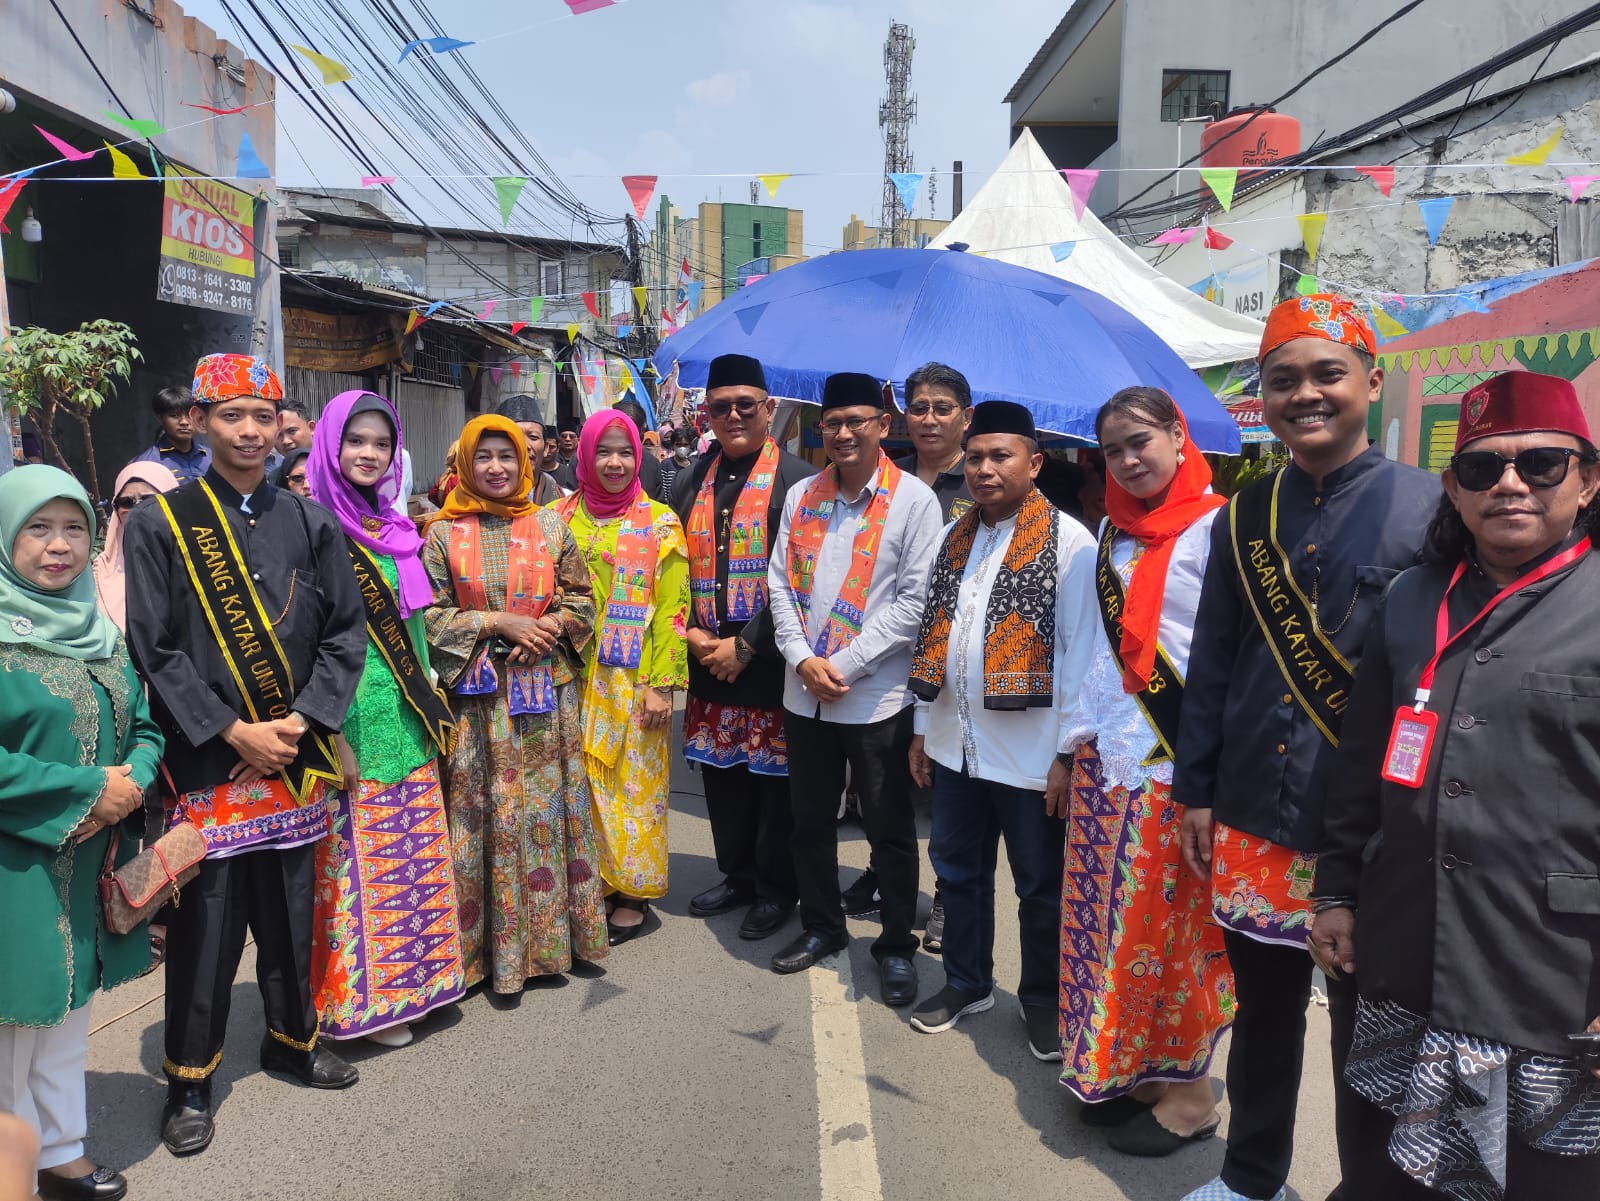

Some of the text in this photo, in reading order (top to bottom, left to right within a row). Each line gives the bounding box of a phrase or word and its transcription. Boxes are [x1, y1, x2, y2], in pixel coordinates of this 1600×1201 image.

[182, 179, 239, 217] DIJUAL
[171, 204, 244, 255] KIOS
[188, 247, 222, 265] HUBUNGI
[176, 265, 196, 281] 0813
[204, 272, 222, 288] 1641
[230, 279, 251, 293] 3300
[176, 284, 196, 299] 0896
[203, 290, 223, 305] 9247
[231, 296, 252, 310] 8176
[1235, 291, 1263, 314] NASI
[1099, 567, 1119, 621] KATAR
[1248, 539, 1290, 614] ABANG
[1280, 614, 1332, 691] KATAR
[192, 527, 290, 720] ABANG KATAR UNIT 0
[353, 563, 414, 676] KATAR UNIT 03
